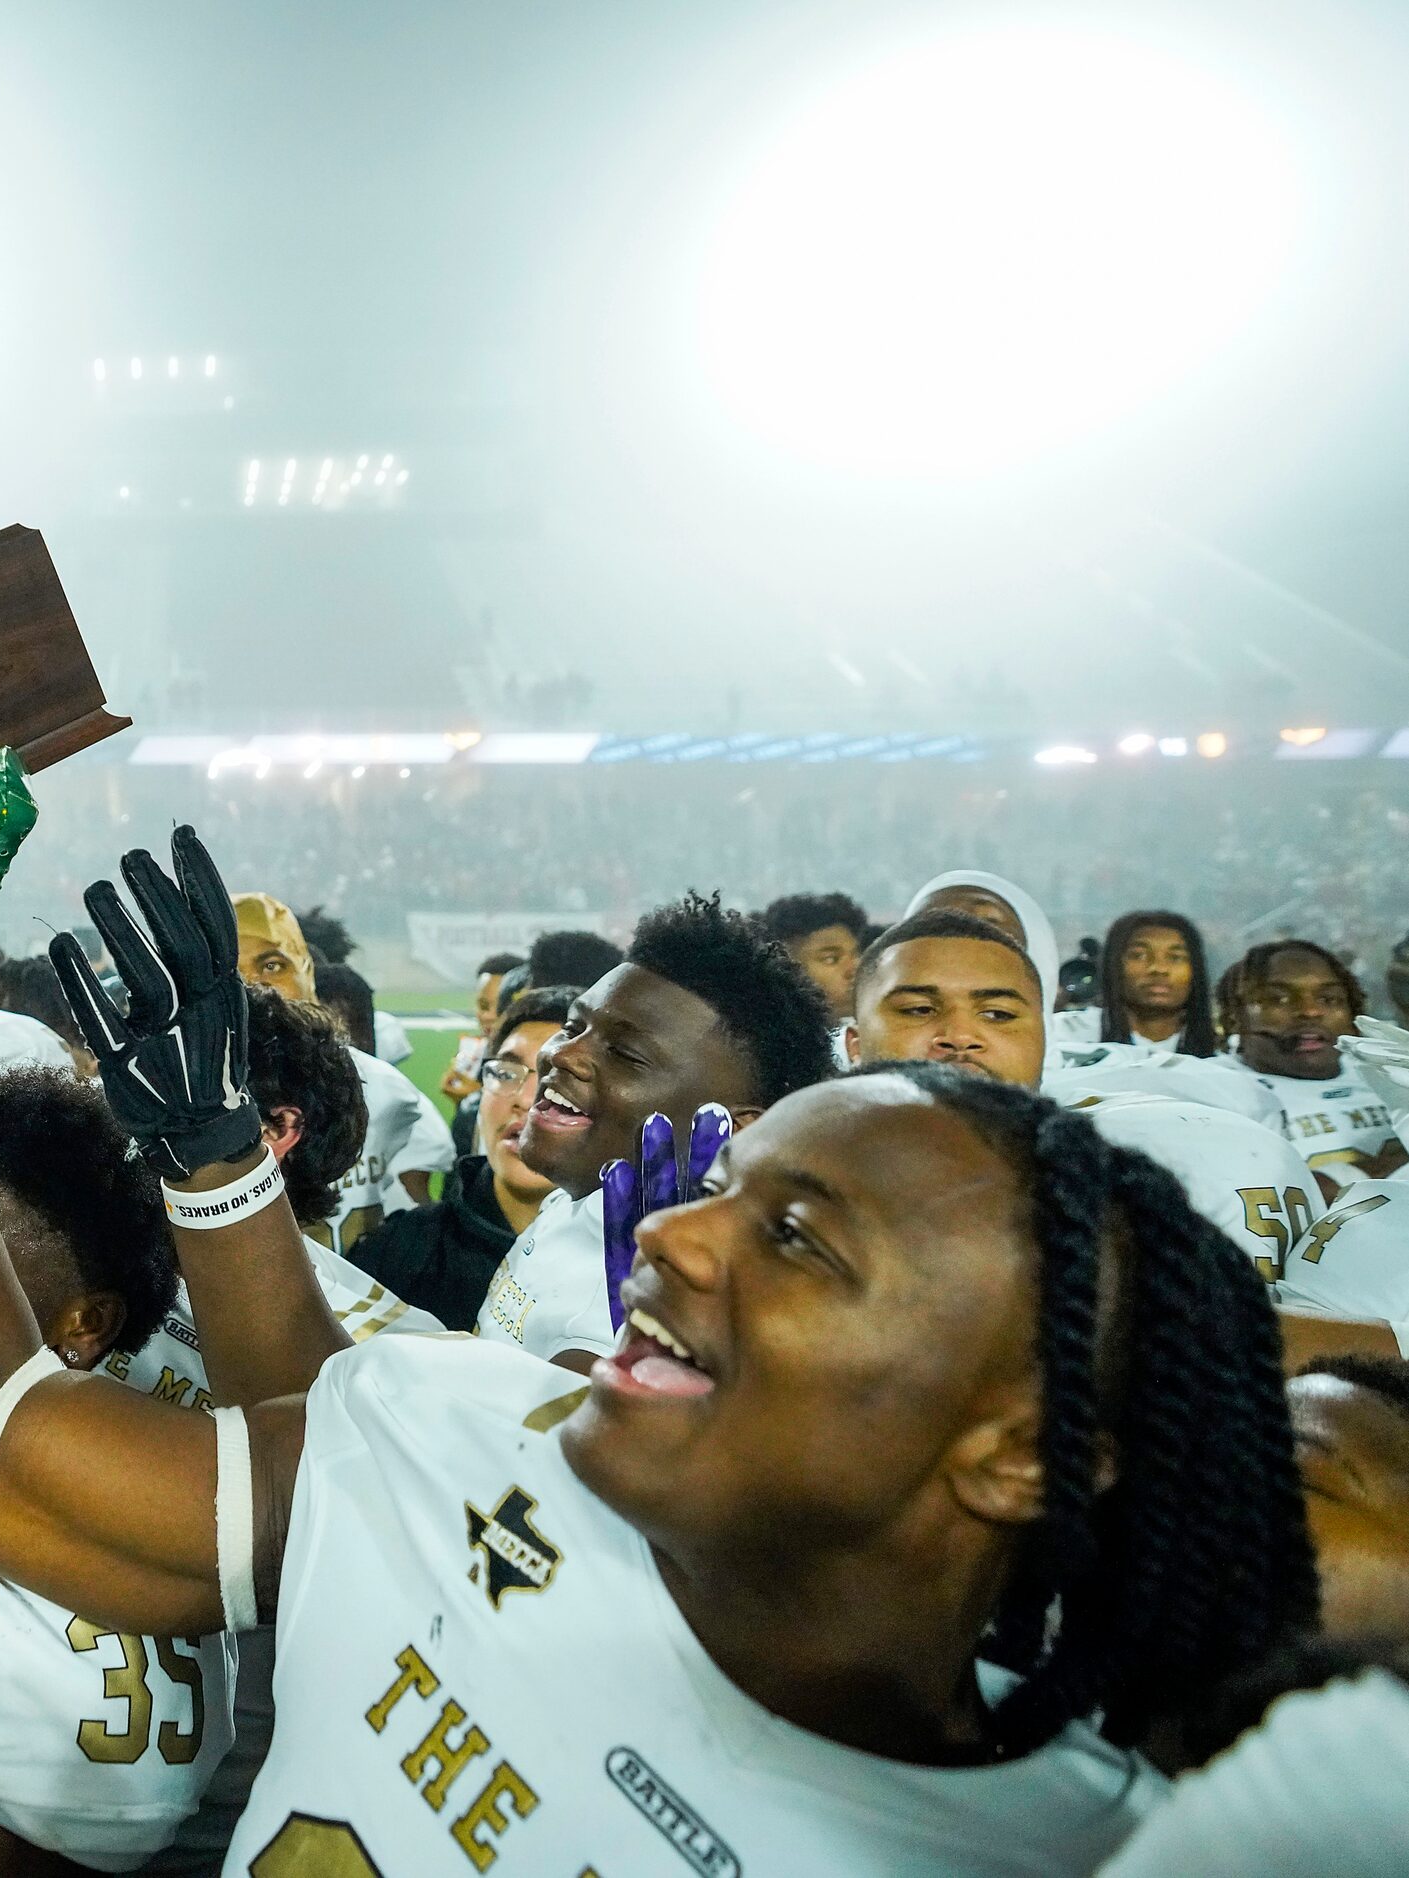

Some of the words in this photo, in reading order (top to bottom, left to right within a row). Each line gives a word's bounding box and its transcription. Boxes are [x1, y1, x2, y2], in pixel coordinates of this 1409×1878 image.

[175, 1201, 230, 1218] BRAKES.
[232, 1192, 249, 1209] NO
[249, 1177, 273, 1198] GAS.
[1235, 1186, 1314, 1284] 50
[168, 1321, 199, 1347] BATT
[480, 1519, 553, 1586] MECCA
[66, 1614, 205, 1765] 35
[364, 1643, 542, 1875] THE
[616, 1756, 732, 1878] BATTLE
